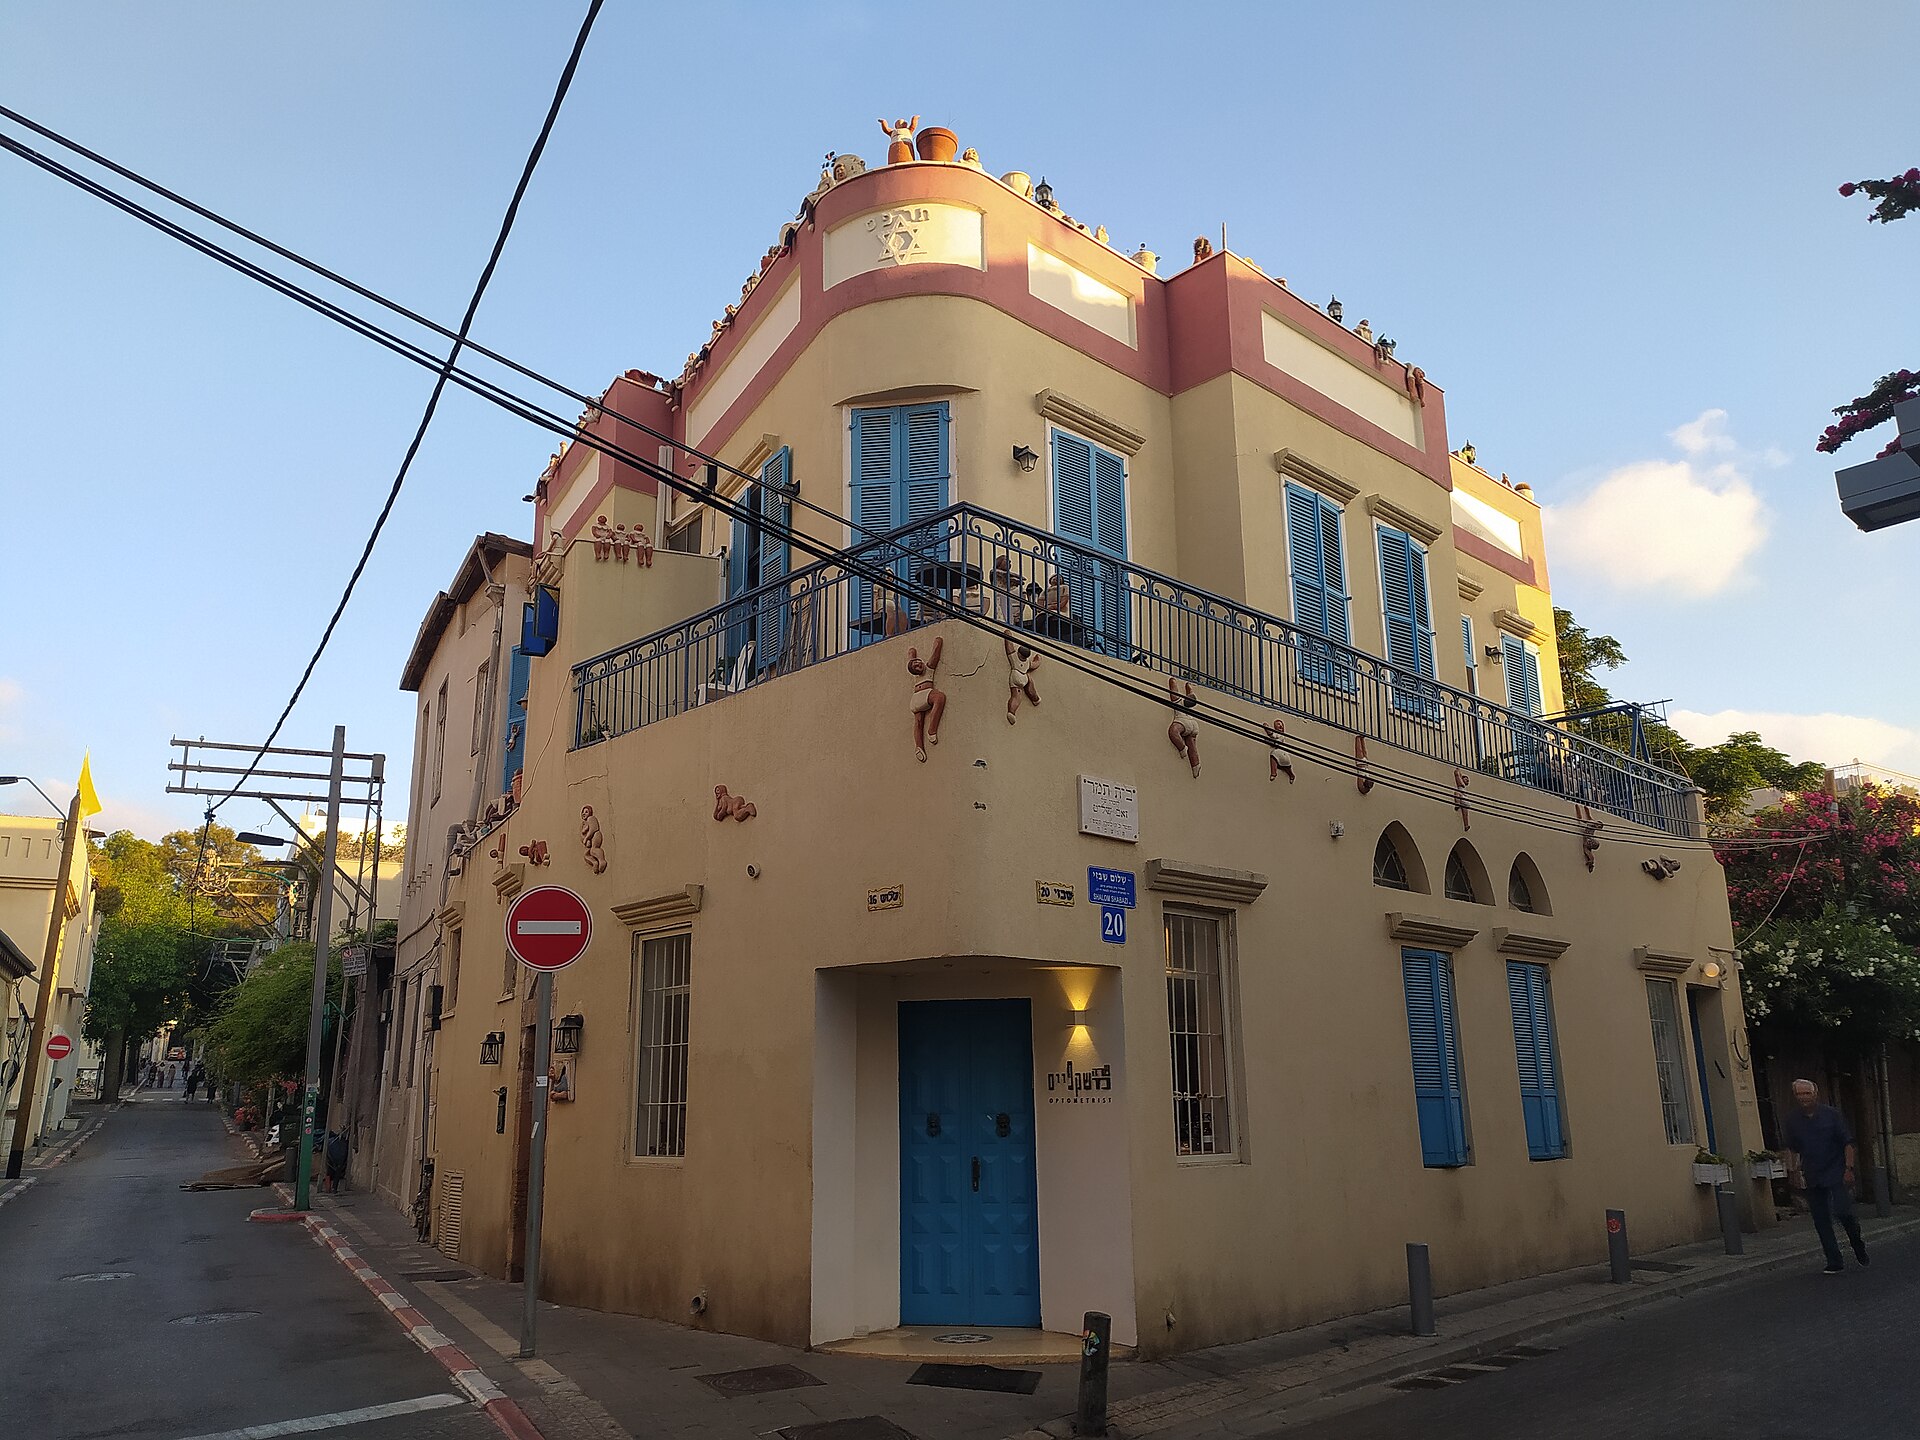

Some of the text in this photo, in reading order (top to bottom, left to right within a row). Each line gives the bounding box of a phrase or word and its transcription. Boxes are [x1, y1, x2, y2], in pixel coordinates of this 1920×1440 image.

[1092, 871, 1108, 882] שבזי
[1040, 886, 1051, 898] 20
[1093, 893, 1111, 902] SHALOM
[1103, 912, 1124, 937] 20
